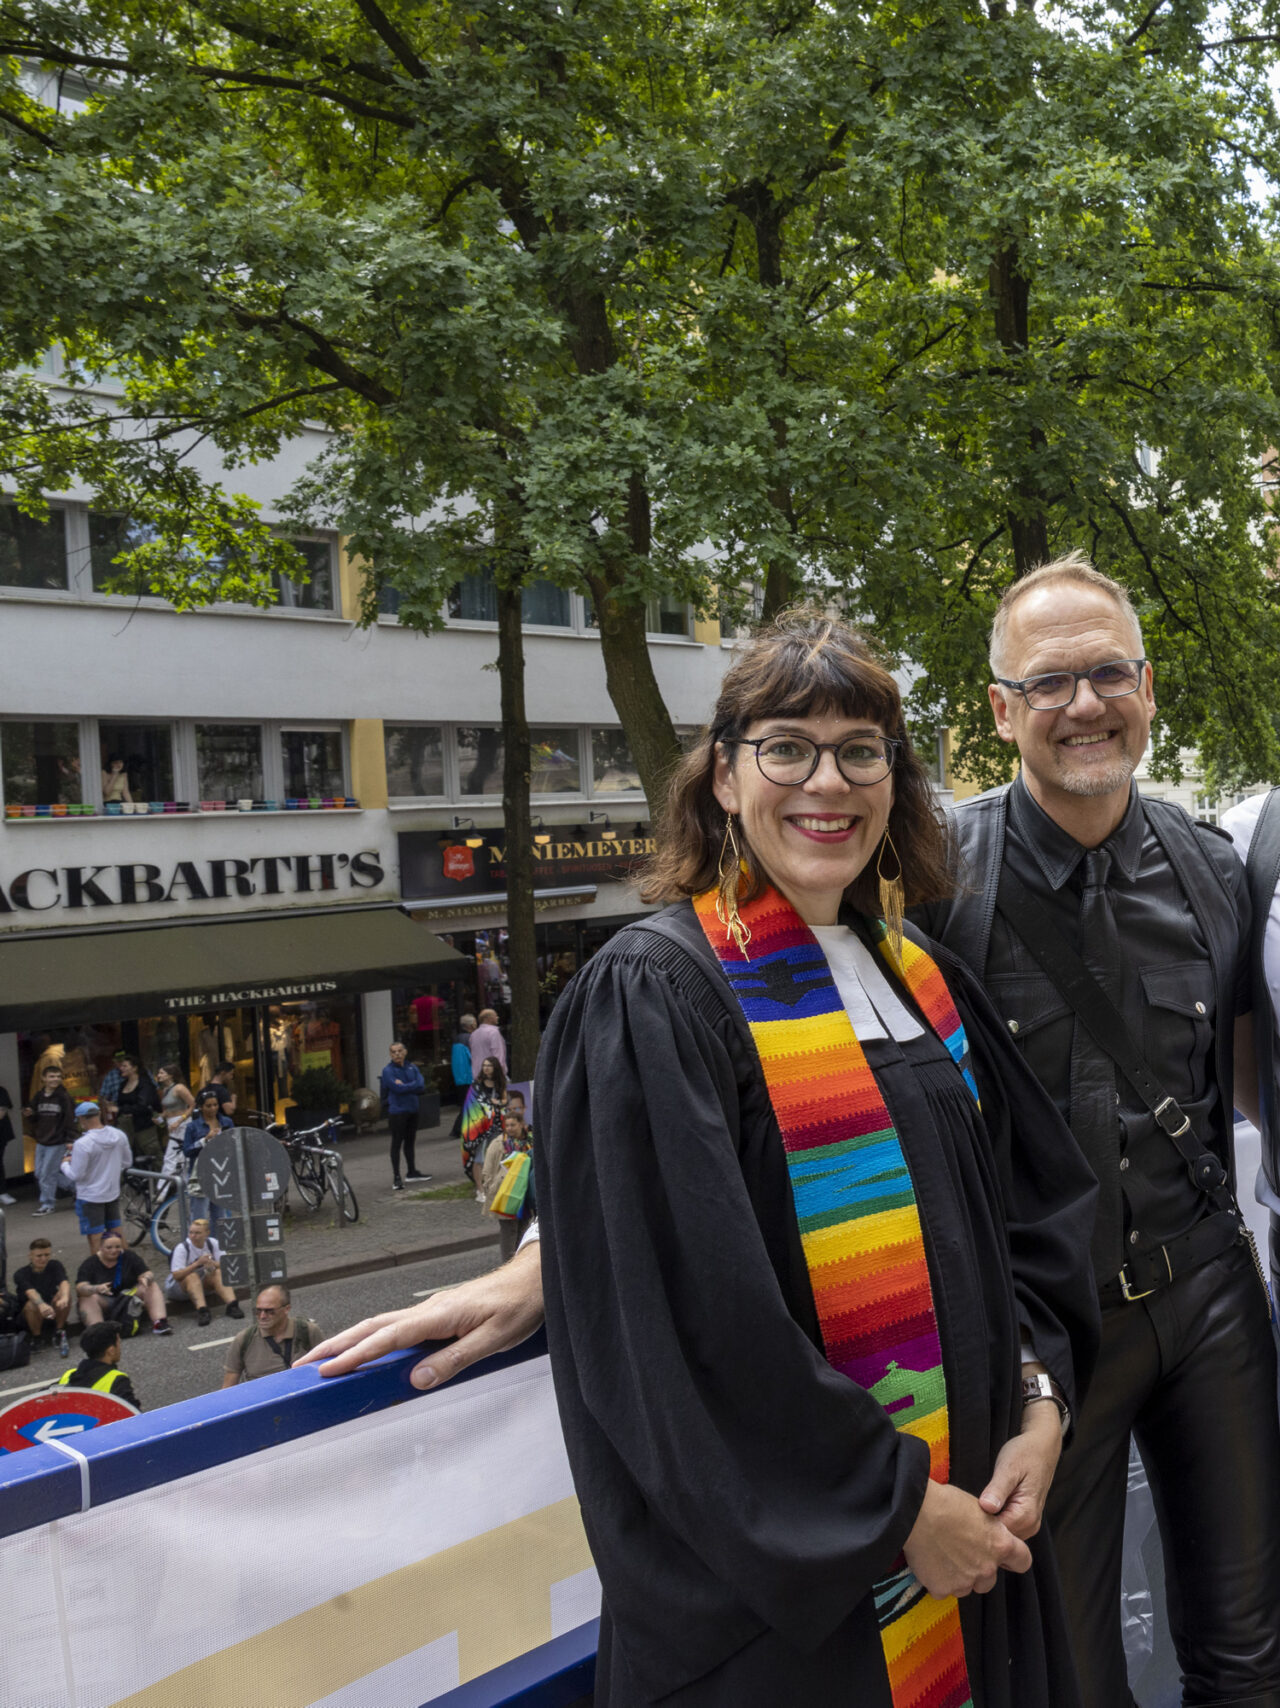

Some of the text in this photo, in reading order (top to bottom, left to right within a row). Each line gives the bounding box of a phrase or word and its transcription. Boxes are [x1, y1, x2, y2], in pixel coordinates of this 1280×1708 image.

[447, 904, 508, 917] NIEMEYE
[165, 981, 337, 1008] THE HACKBARTH'S
